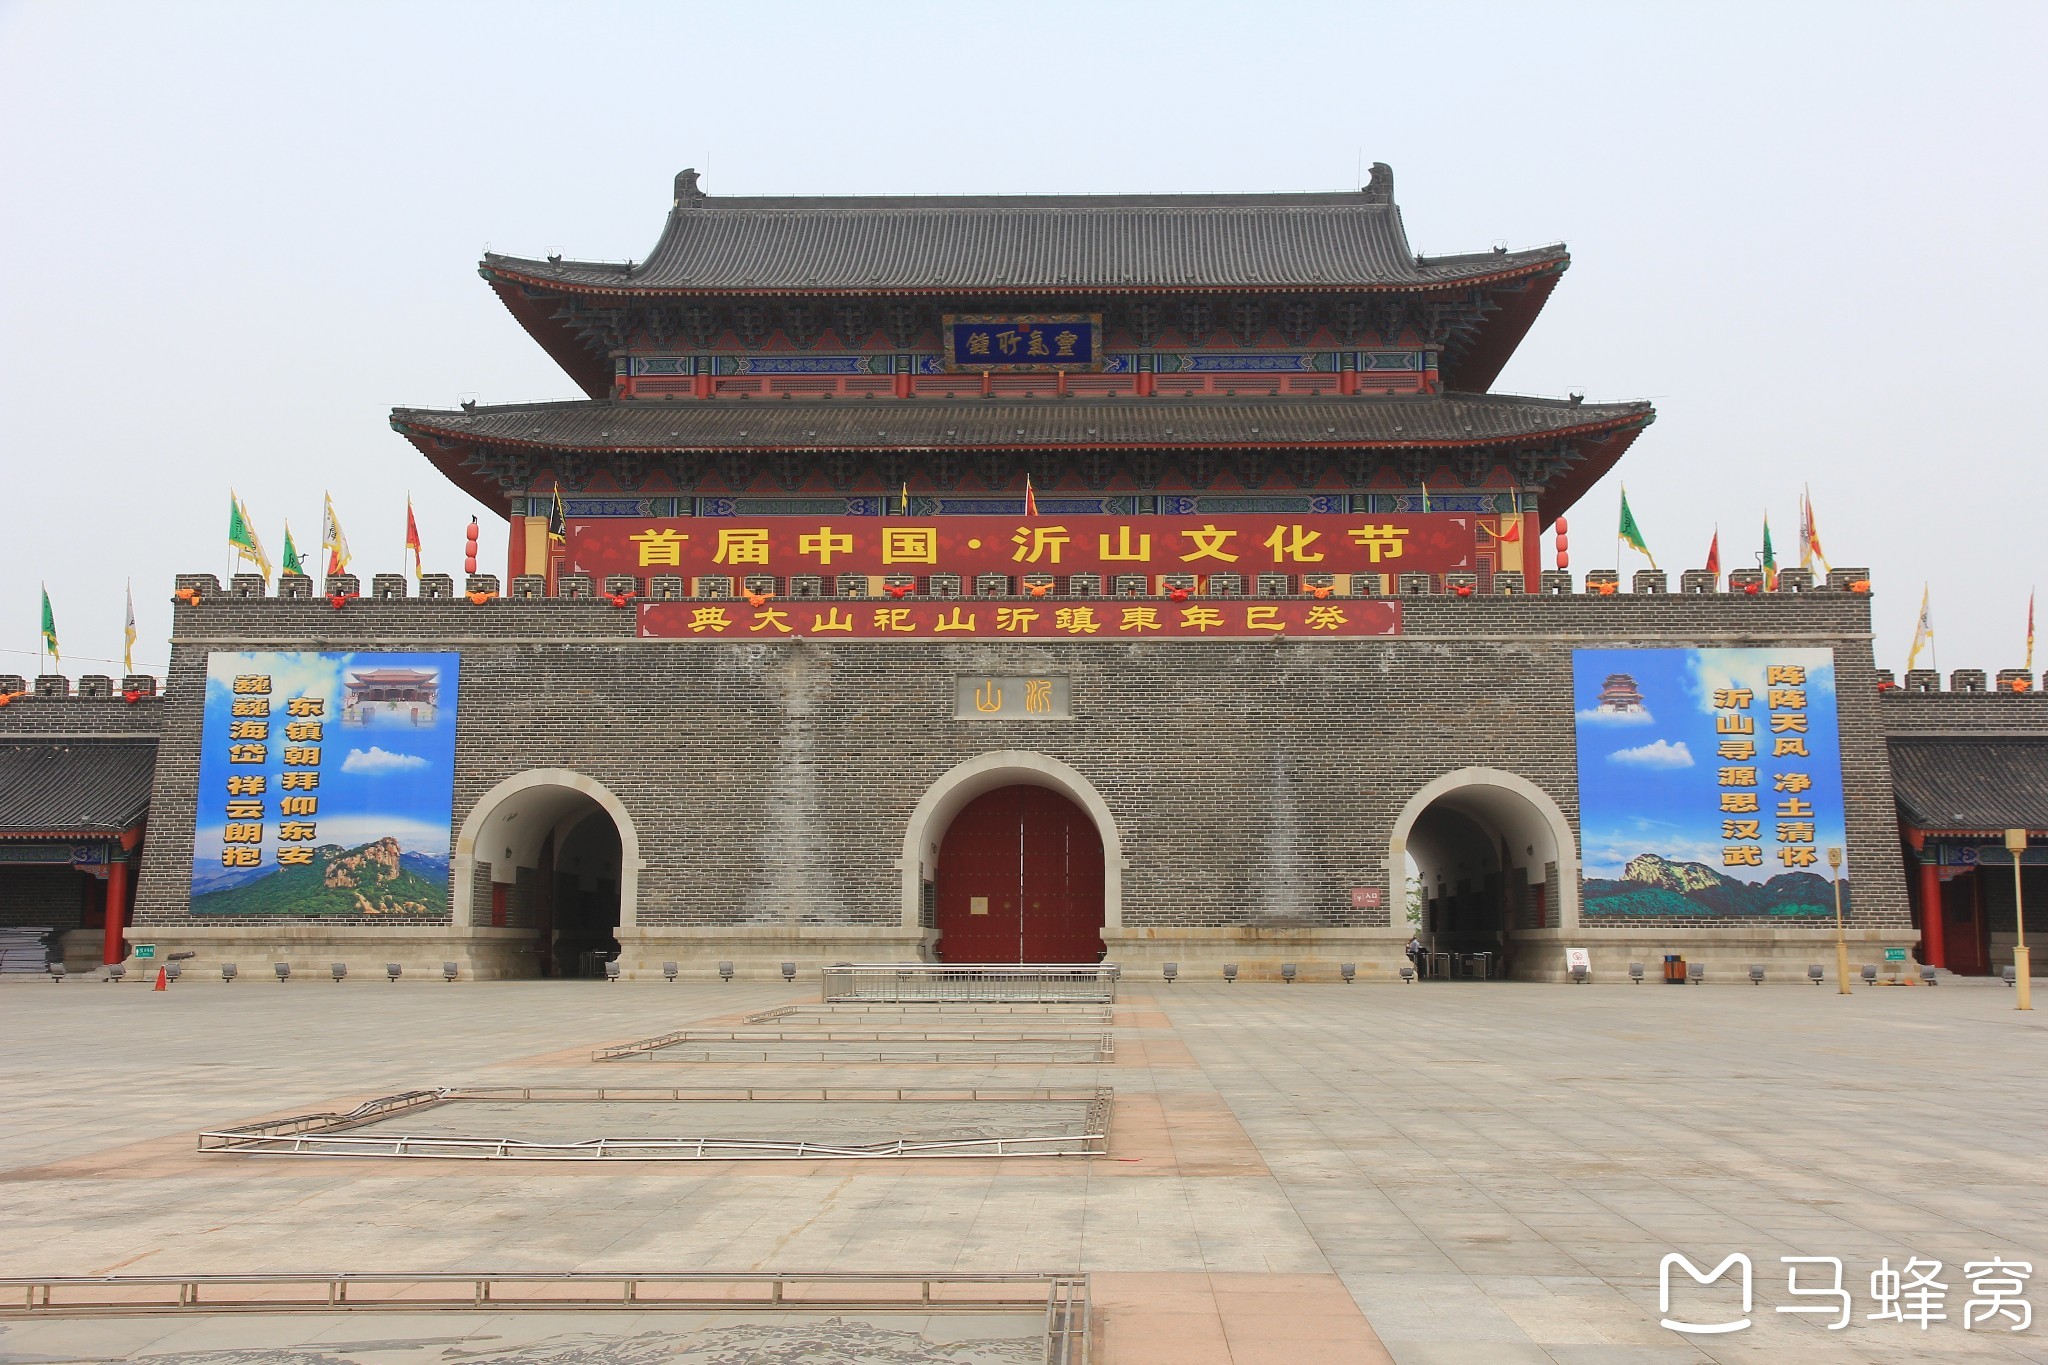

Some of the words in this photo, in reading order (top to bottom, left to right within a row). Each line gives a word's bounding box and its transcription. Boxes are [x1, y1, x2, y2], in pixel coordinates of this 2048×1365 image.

[276, 696, 324, 866] 东镇朝拜仰东安
[1713, 687, 1762, 867] 沂山寻源思汉武
